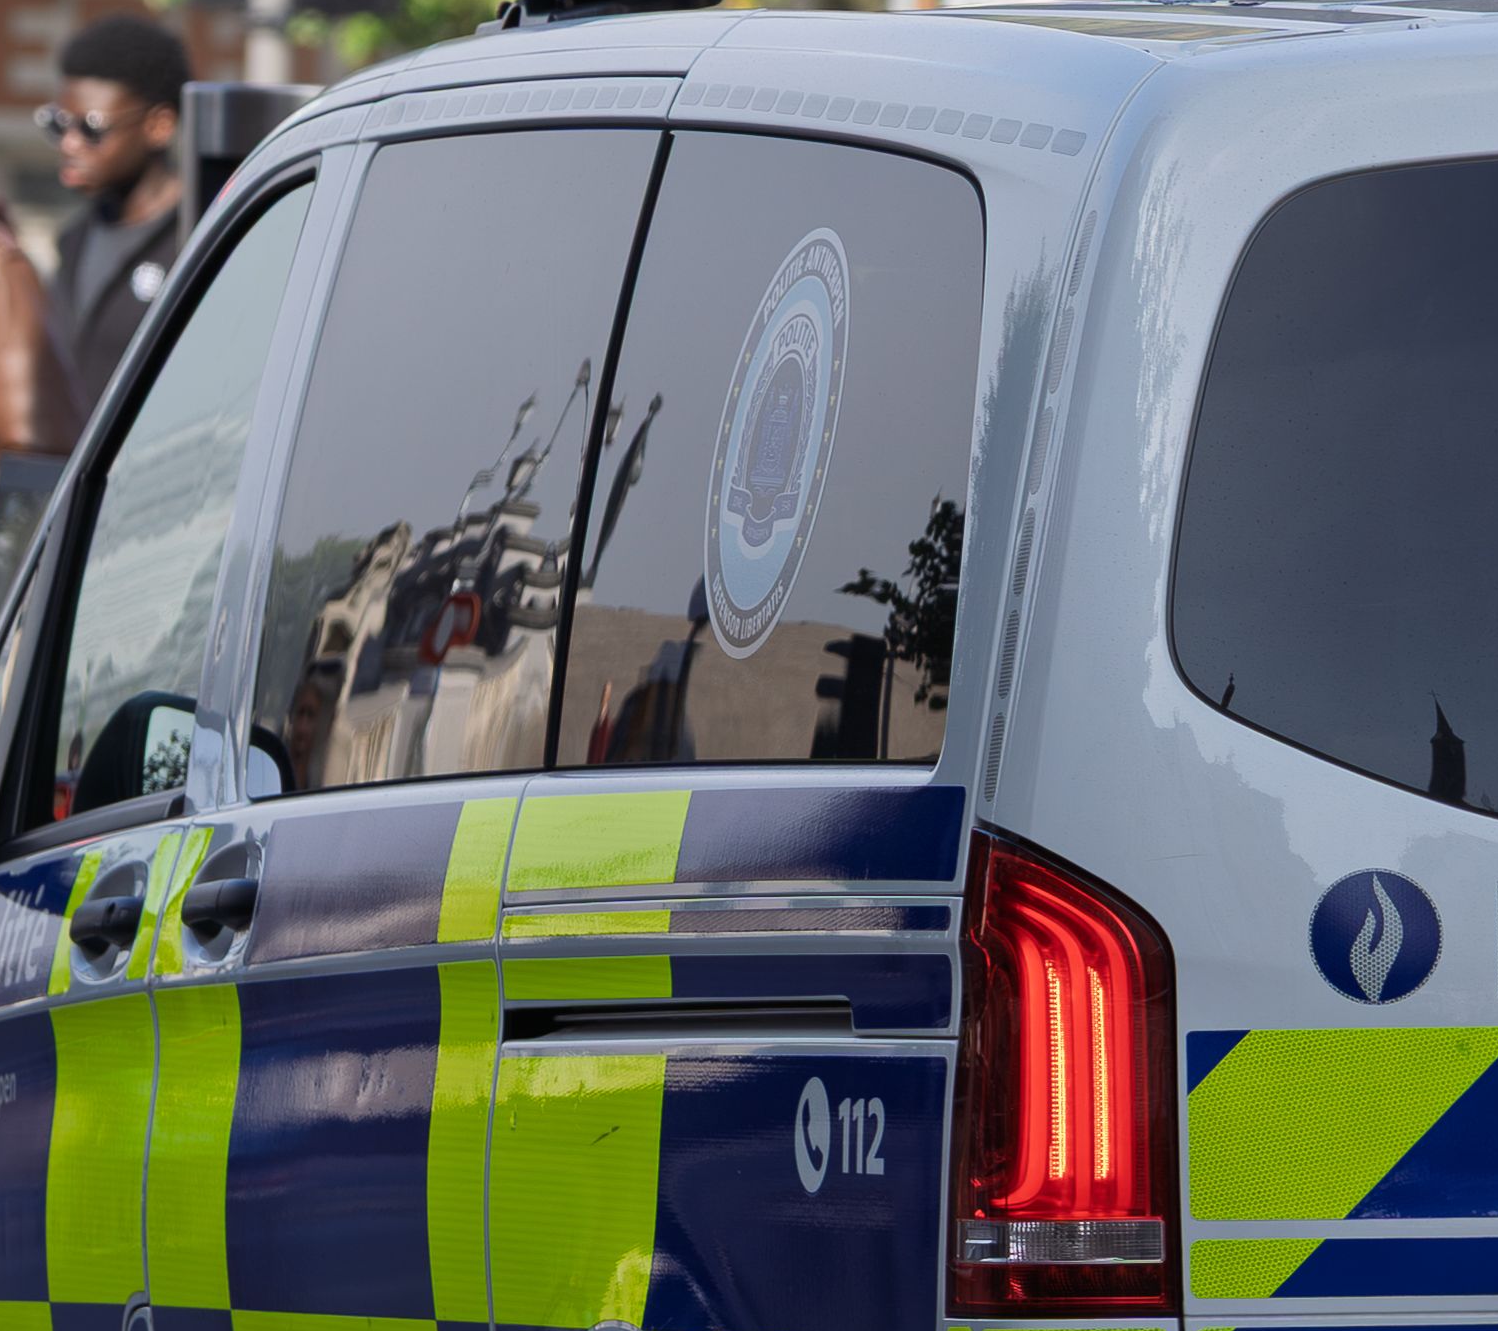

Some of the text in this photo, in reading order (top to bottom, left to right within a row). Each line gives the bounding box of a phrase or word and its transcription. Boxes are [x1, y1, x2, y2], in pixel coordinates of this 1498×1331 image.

[763, 244, 845, 330] POLITIE ANTWERPEN
[777, 320, 816, 360] POLITIE
[712, 572, 784, 640] DEFENSOR LIBERTATIS
[838, 1096, 886, 1176] 112
